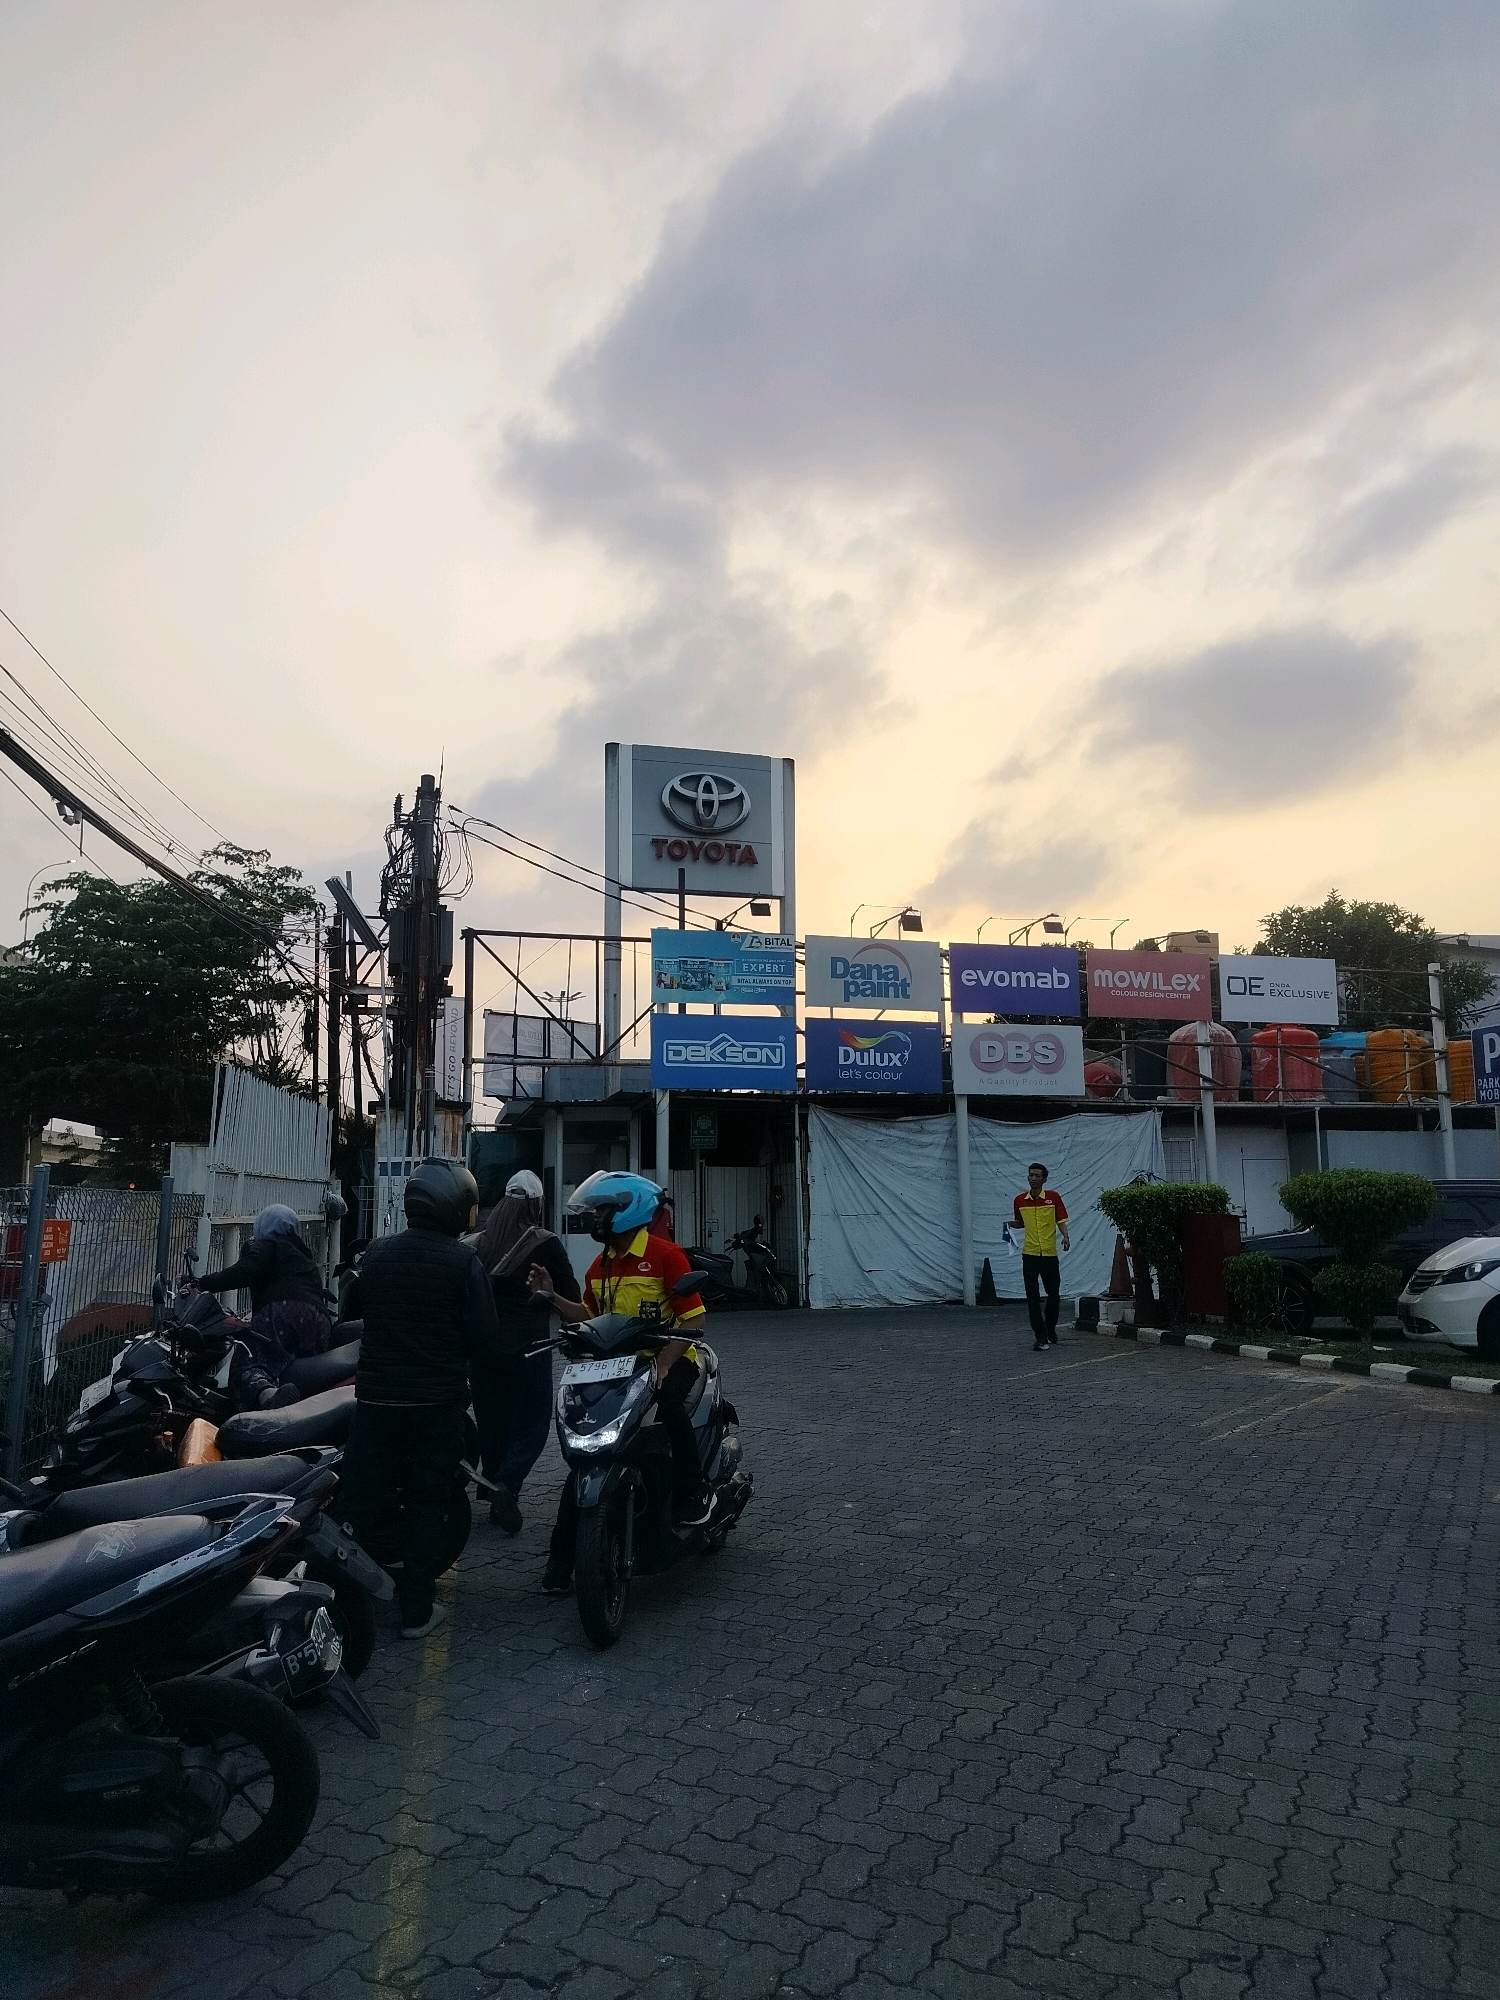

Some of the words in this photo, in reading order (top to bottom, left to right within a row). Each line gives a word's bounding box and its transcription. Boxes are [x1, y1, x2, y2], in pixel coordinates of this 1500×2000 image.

[652, 838, 758, 865] TOYOTA
[765, 937, 792, 947] BITAL
[743, 963, 786, 973] EXPERT
[830, 956, 899, 981] Dana
[961, 966, 1070, 990] evomab
[843, 977, 910, 1002] paint
[1165, 992, 1191, 1000] CENTER
[1227, 976, 1265, 996] OE
[1269, 988, 1330, 999] EXCLUSIVE
[449, 1008, 459, 1053] BEYOND
[838, 1046, 903, 1067] Dulux
[979, 1040, 1057, 1065] DBS
[1482, 1032, 1500, 1074] P
[448, 1055, 457, 1073] GO
[838, 1068, 862, 1079] let's
[865, 1069, 903, 1081] colour
[979, 1077, 985, 1085] A
[987, 1078, 1020, 1087] Quality
[1023, 1078, 1058, 1086] Product
[566, 1365, 574, 1375] B
[580, 1361, 608, 1372] 5796
[286, 1654, 300, 1675] B
